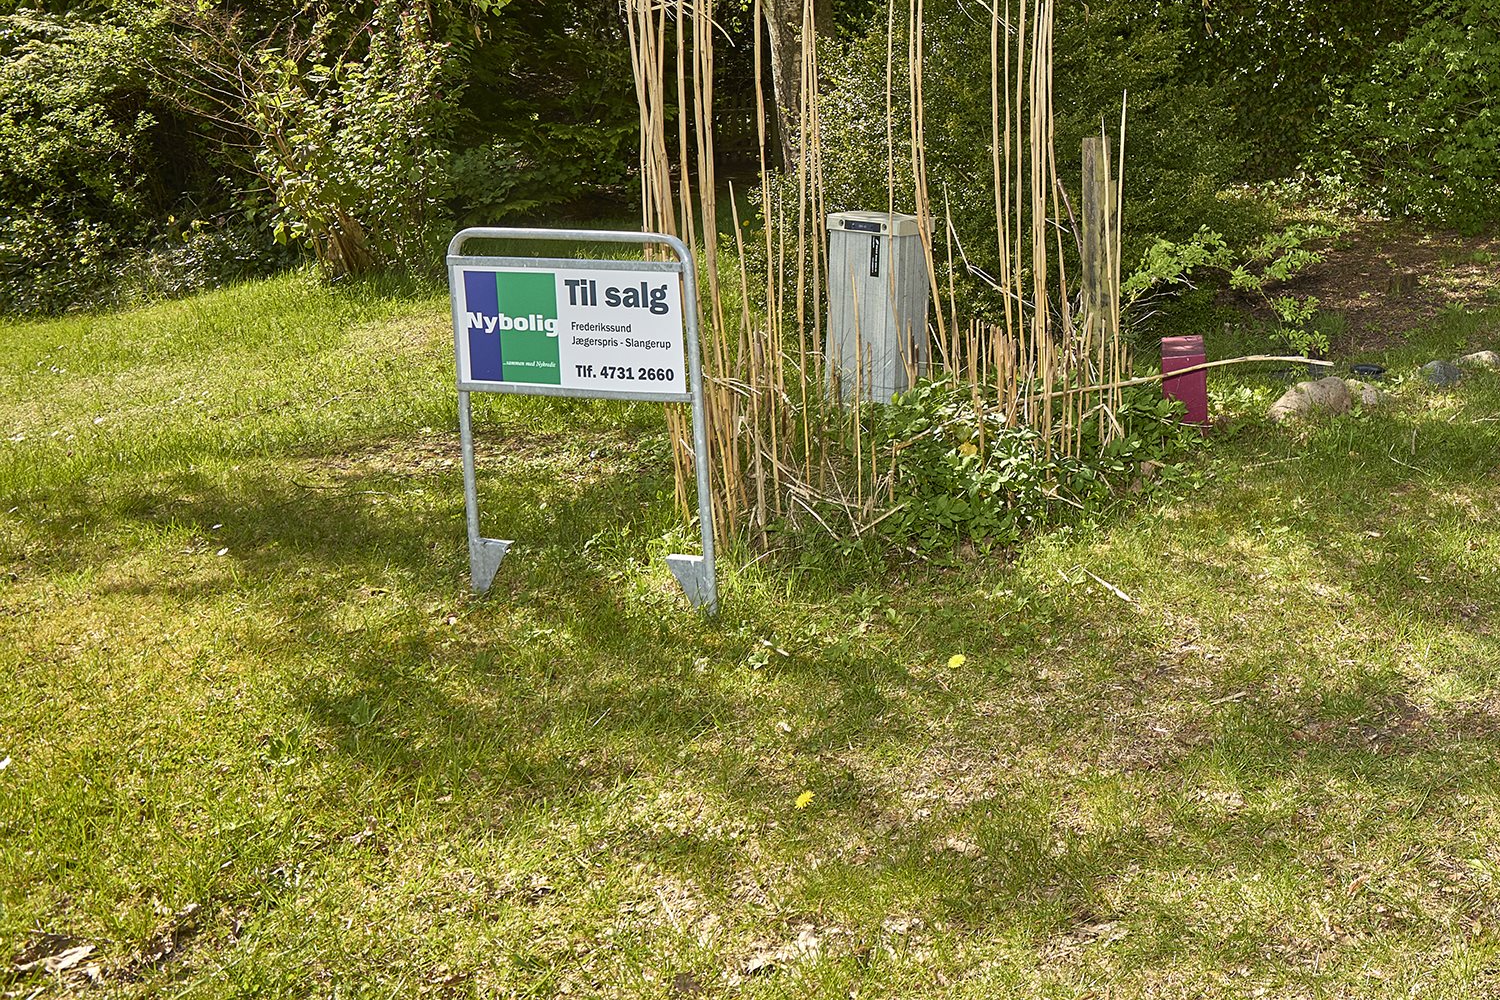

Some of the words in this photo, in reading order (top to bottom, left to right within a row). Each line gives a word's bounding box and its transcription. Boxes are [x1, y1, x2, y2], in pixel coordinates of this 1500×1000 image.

[564, 279, 597, 307] Til
[605, 281, 669, 315] salg
[466, 312, 559, 337] Nybolig
[571, 321, 632, 333] Frederikssund
[571, 336, 619, 348] Jægerspris
[625, 337, 672, 350] Slangerup
[575, 364, 597, 378] Tlf.
[600, 366, 635, 380] 4731
[638, 367, 675, 382] 2660
